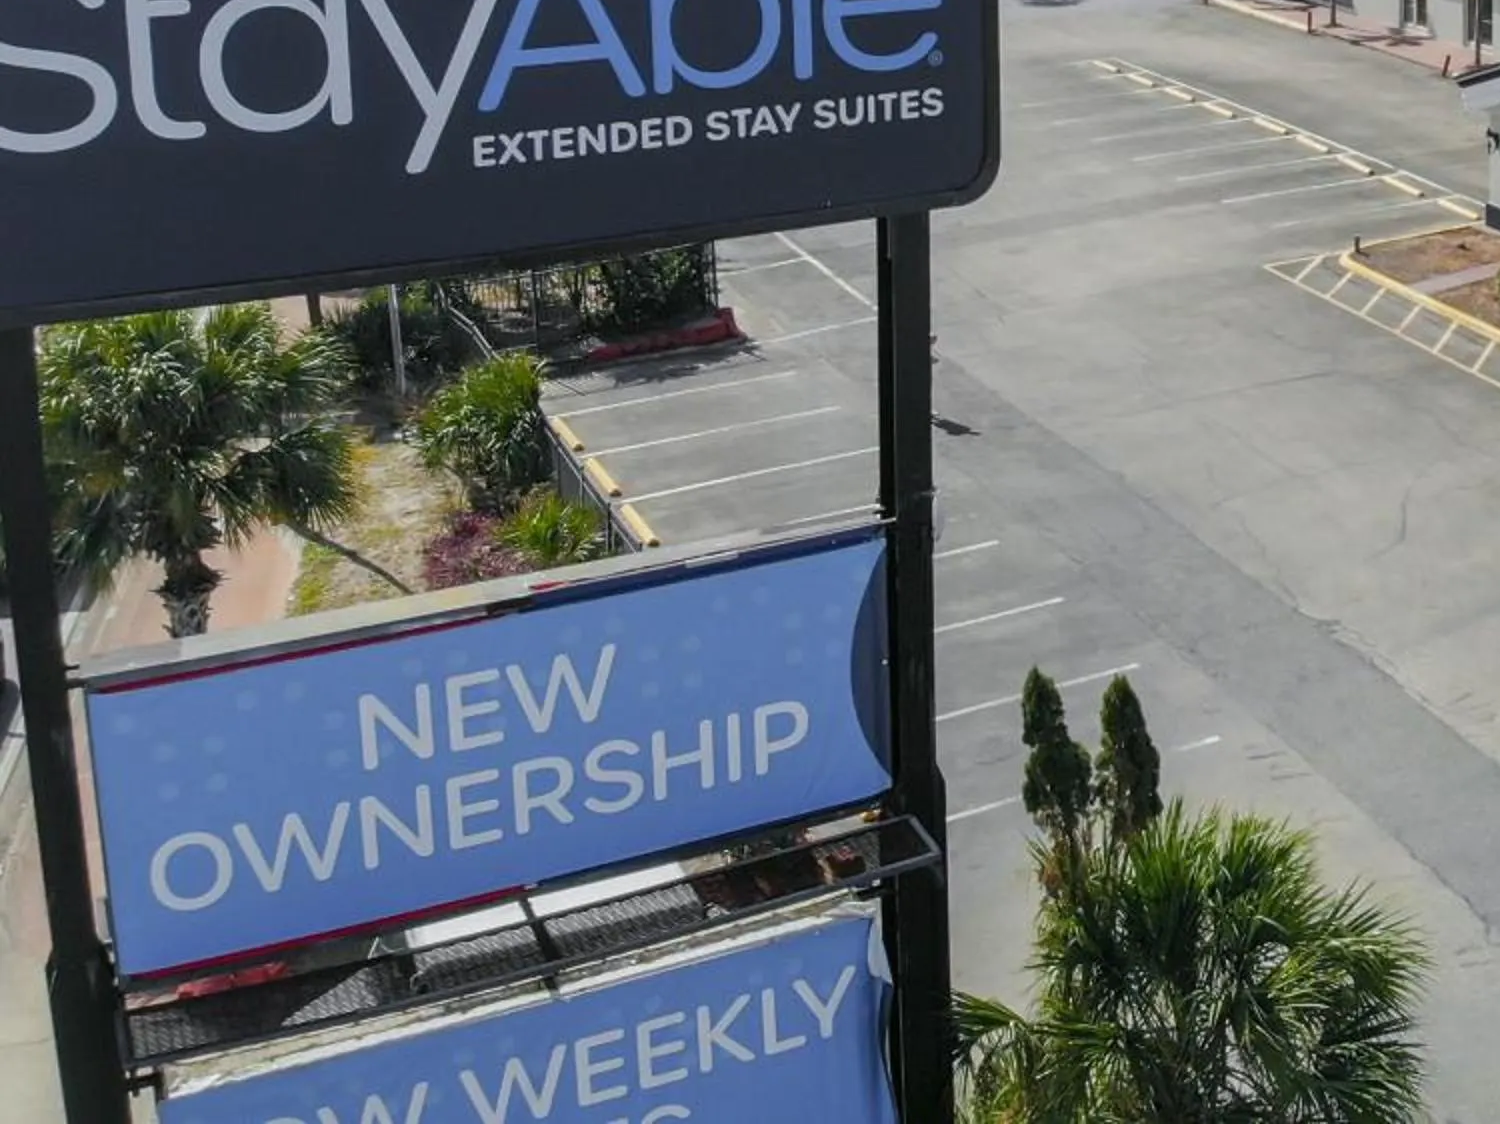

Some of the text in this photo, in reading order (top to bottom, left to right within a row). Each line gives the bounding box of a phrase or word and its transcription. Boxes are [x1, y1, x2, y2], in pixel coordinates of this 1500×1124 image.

[473, 87, 944, 168] EXTENDED STAY SUITES
[358, 643, 617, 771] NEW
[150, 700, 809, 911] OWNERSHIP
[459, 966, 855, 1124] WEEKLY
